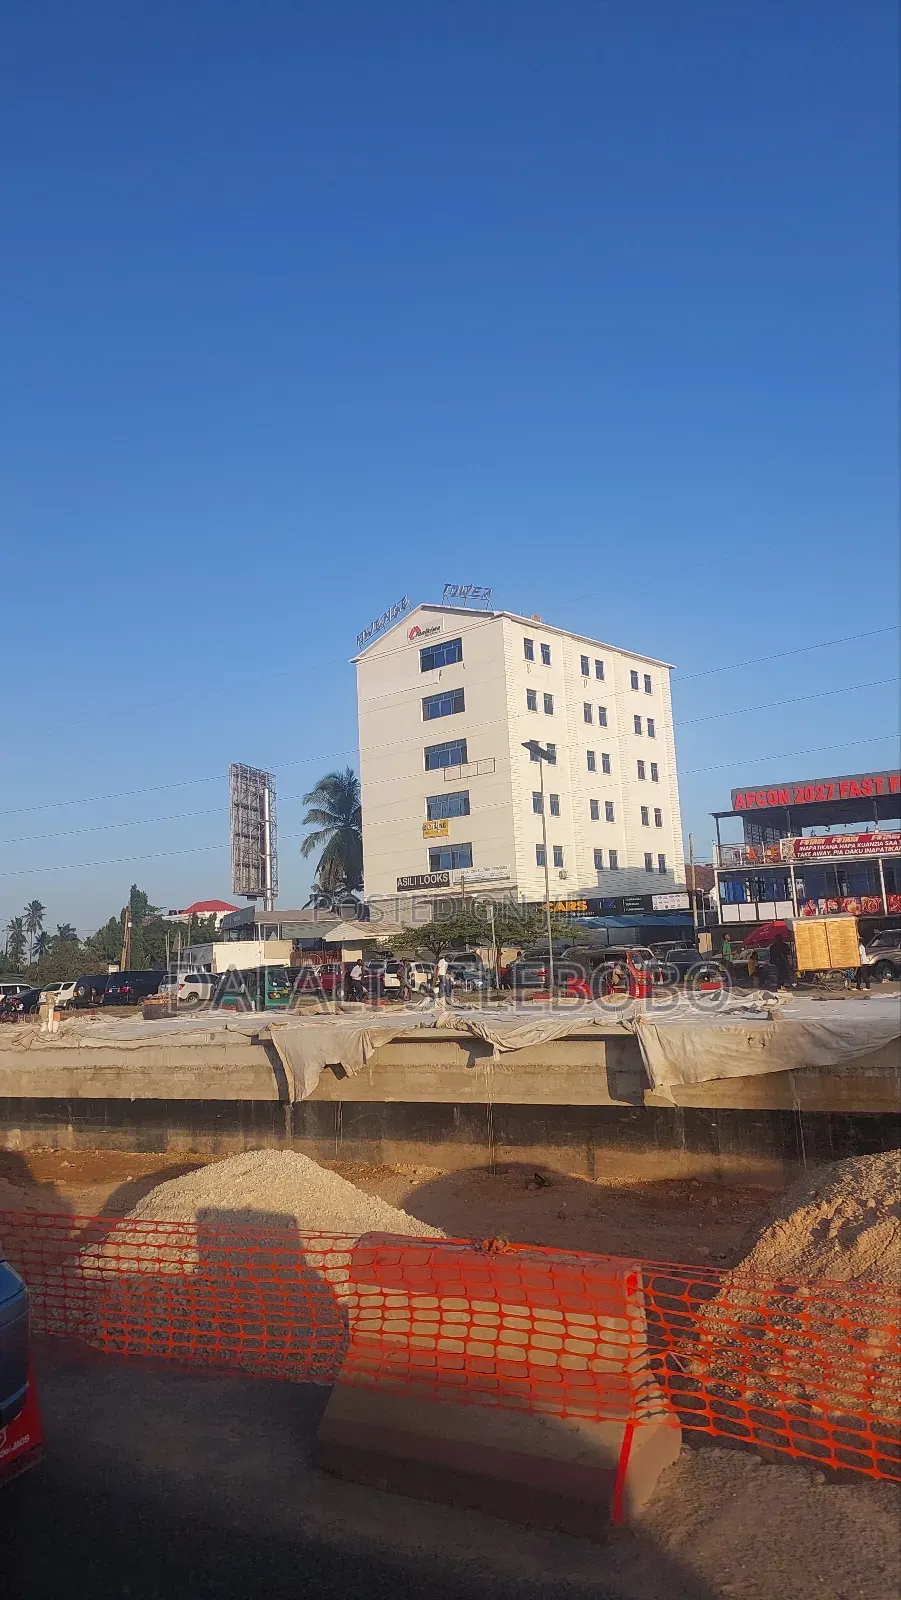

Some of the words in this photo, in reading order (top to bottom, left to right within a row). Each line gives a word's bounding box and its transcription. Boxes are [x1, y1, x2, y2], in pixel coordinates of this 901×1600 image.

[443, 583, 493, 599] TOWER
[734, 788, 790, 810] AFCON
[793, 783, 835, 804] 2027
[839, 777, 884, 799] FAST
[799, 844, 839, 852] INAPATIKANA
[839, 842, 857, 850] HAPA
[857, 840, 884, 848] KUANZIA
[844, 847, 863, 855] DAKU
[397, 877, 417, 887] ASILI
[419, 873, 448, 885] LOOKS
[543, 900, 588, 913] CARS
